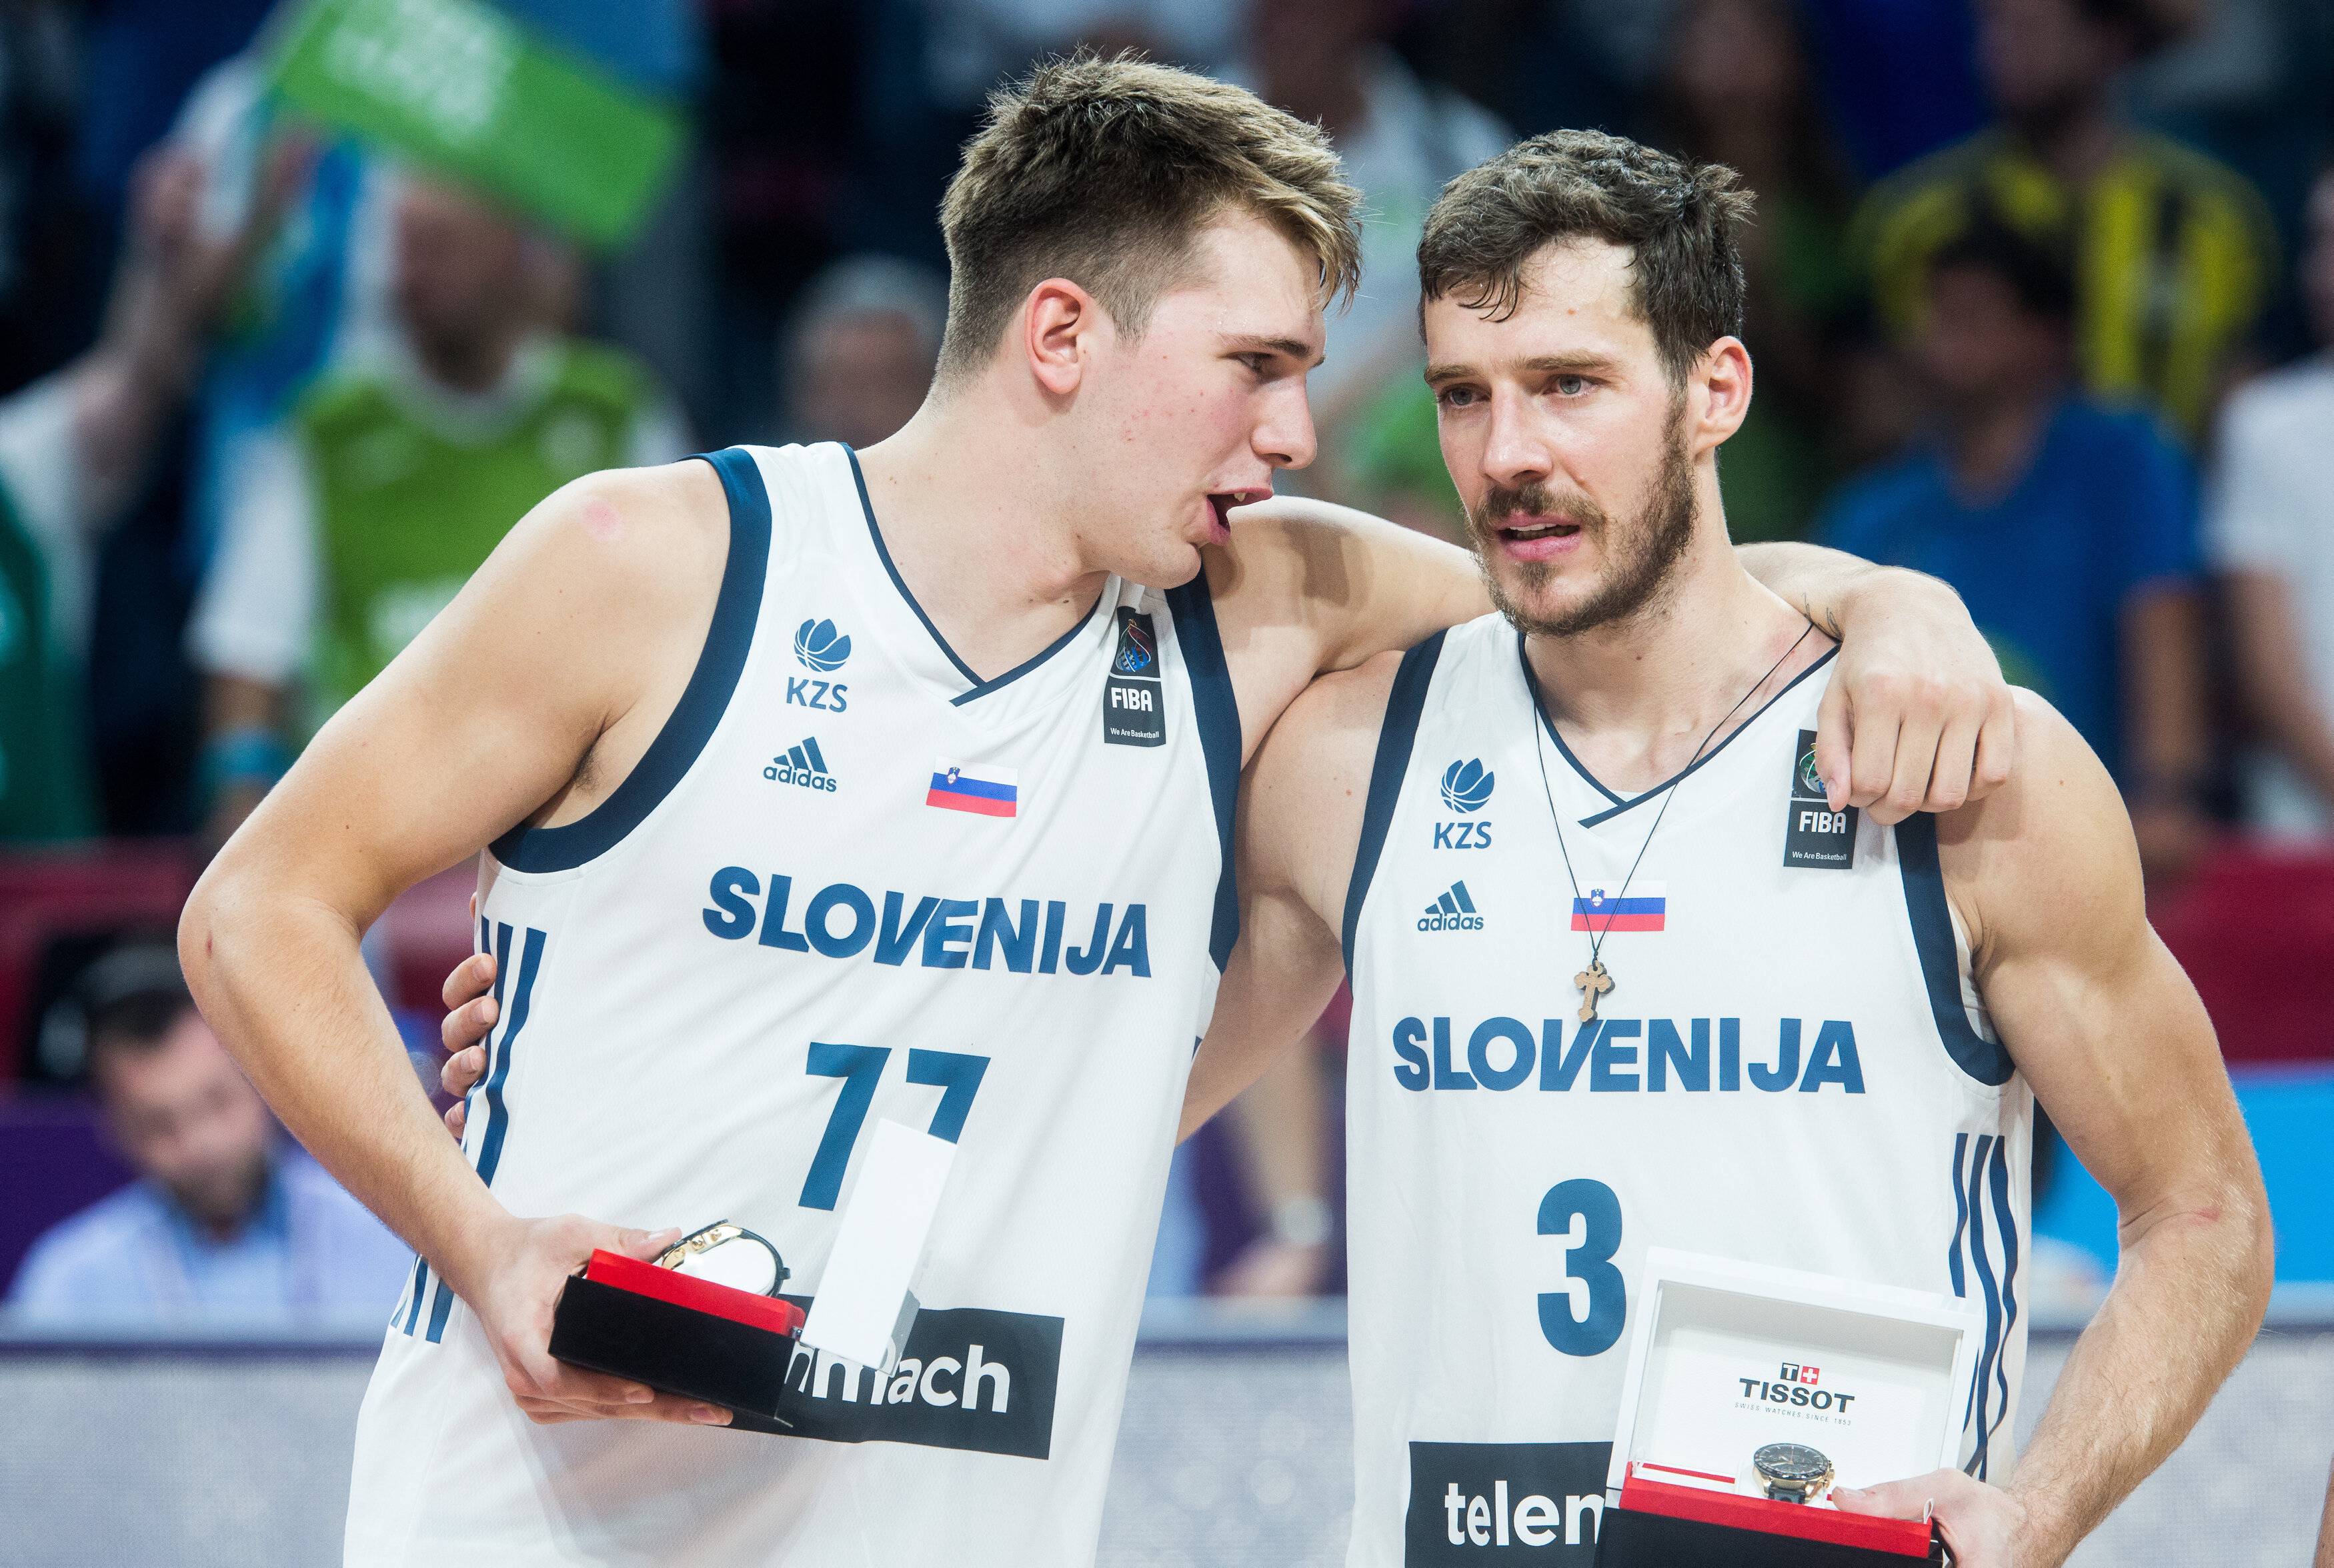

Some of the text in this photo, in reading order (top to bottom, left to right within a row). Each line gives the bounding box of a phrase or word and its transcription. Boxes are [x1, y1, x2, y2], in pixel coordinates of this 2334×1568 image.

[786, 677, 848, 713] KZS
[1111, 687, 1153, 712] FIBA
[1110, 727, 1160, 739] We Are Basketball
[763, 766, 837, 792] adidas
[1434, 821, 1492, 849] KZS
[1799, 811, 1847, 833] FIBA
[1815, 853, 1847, 861] Basketball
[702, 866, 1152, 978] SLOVENIJA
[1417, 913, 1484, 931] adidas
[1392, 1017, 1866, 1093] SLOVENIJA
[798, 1042, 991, 1211] 77
[1537, 1179, 1626, 1357] 3
[1739, 1377, 1855, 1413] TISSOT
[1734, 1402, 1760, 1411] SWISS
[1765, 1407, 1801, 1418] WATCHES
[1806, 1413, 1829, 1422] SINCE
